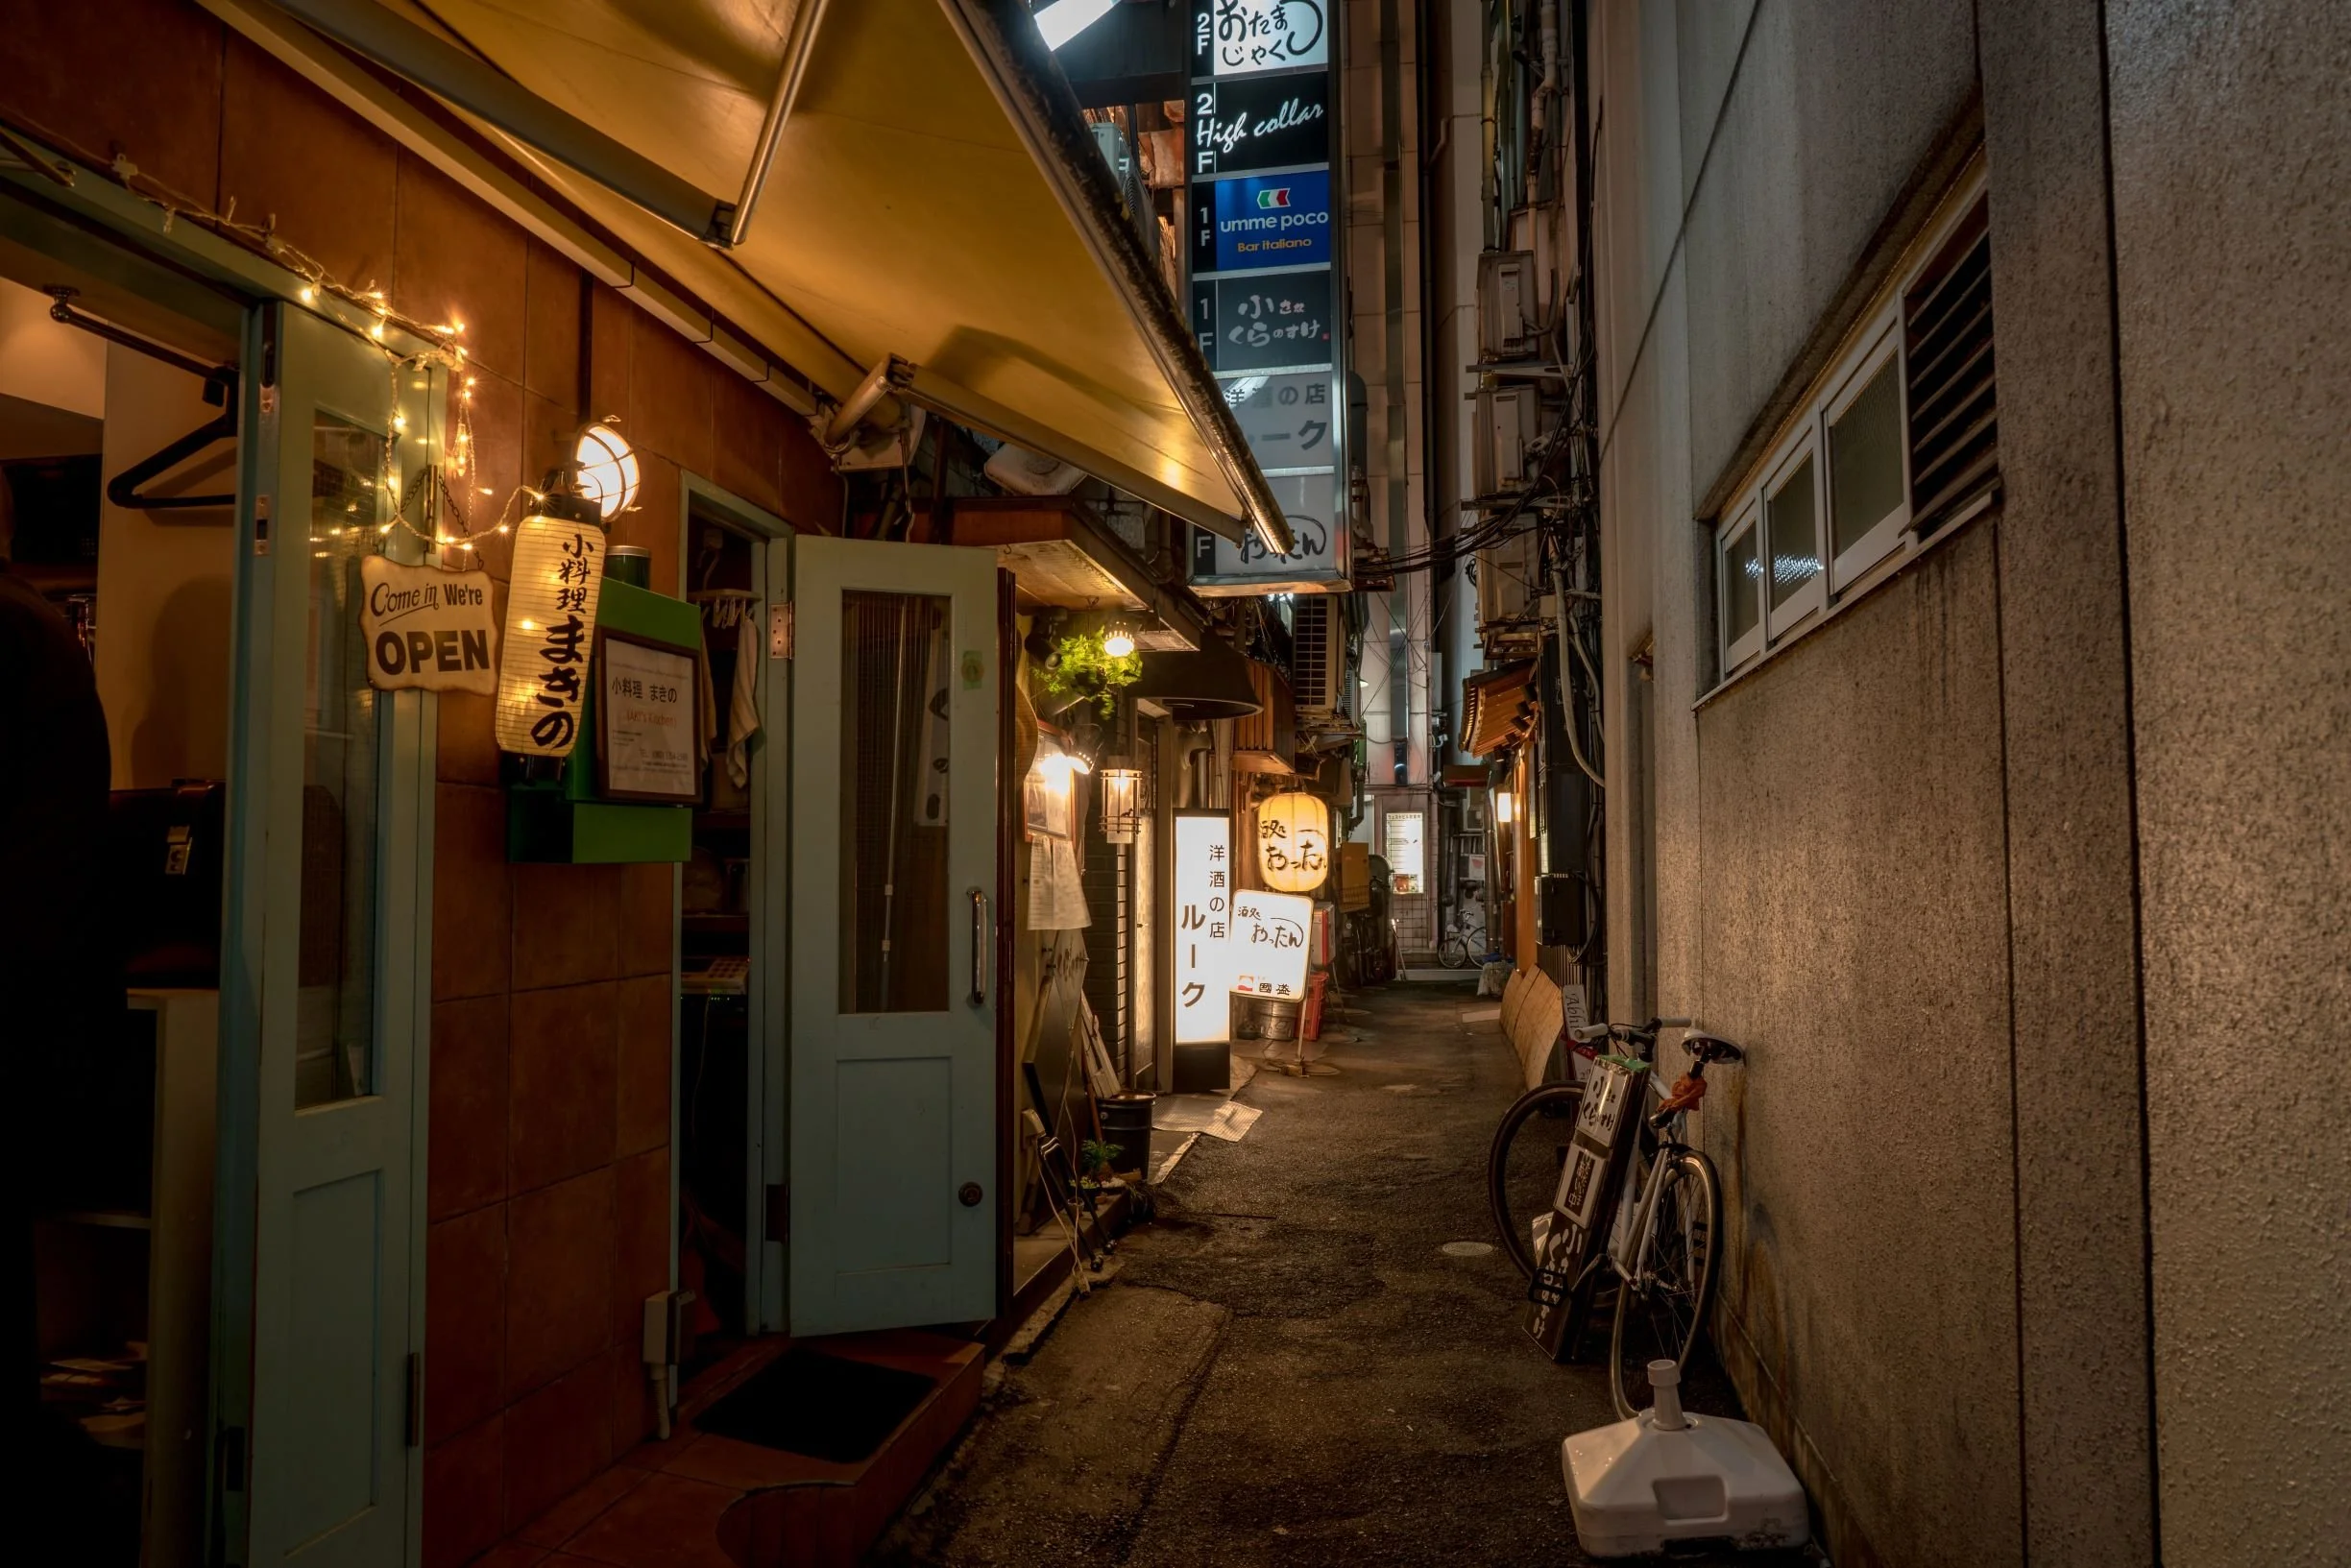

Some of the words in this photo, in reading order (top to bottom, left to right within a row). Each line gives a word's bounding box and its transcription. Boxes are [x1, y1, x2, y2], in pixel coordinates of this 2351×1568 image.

[1197, 111, 1248, 154] High
[1253, 98, 1323, 137] collar
[1220, 214, 1278, 233] umme
[1280, 211, 1329, 231] poco
[1237, 241, 1260, 253] Bar
[1262, 236, 1312, 251] italiano
[1249, 420, 1328, 451] ーク
[370, 582, 421, 618] Come
[423, 583, 440, 611] in
[444, 583, 483, 607] We're
[375, 629, 491, 676] OPEN
[612, 676, 643, 699] 小料理
[649, 683, 677, 704] まきの
[1209, 844, 1225, 939] 洋酒の店
[1181, 904, 1206, 1008] ルーク
